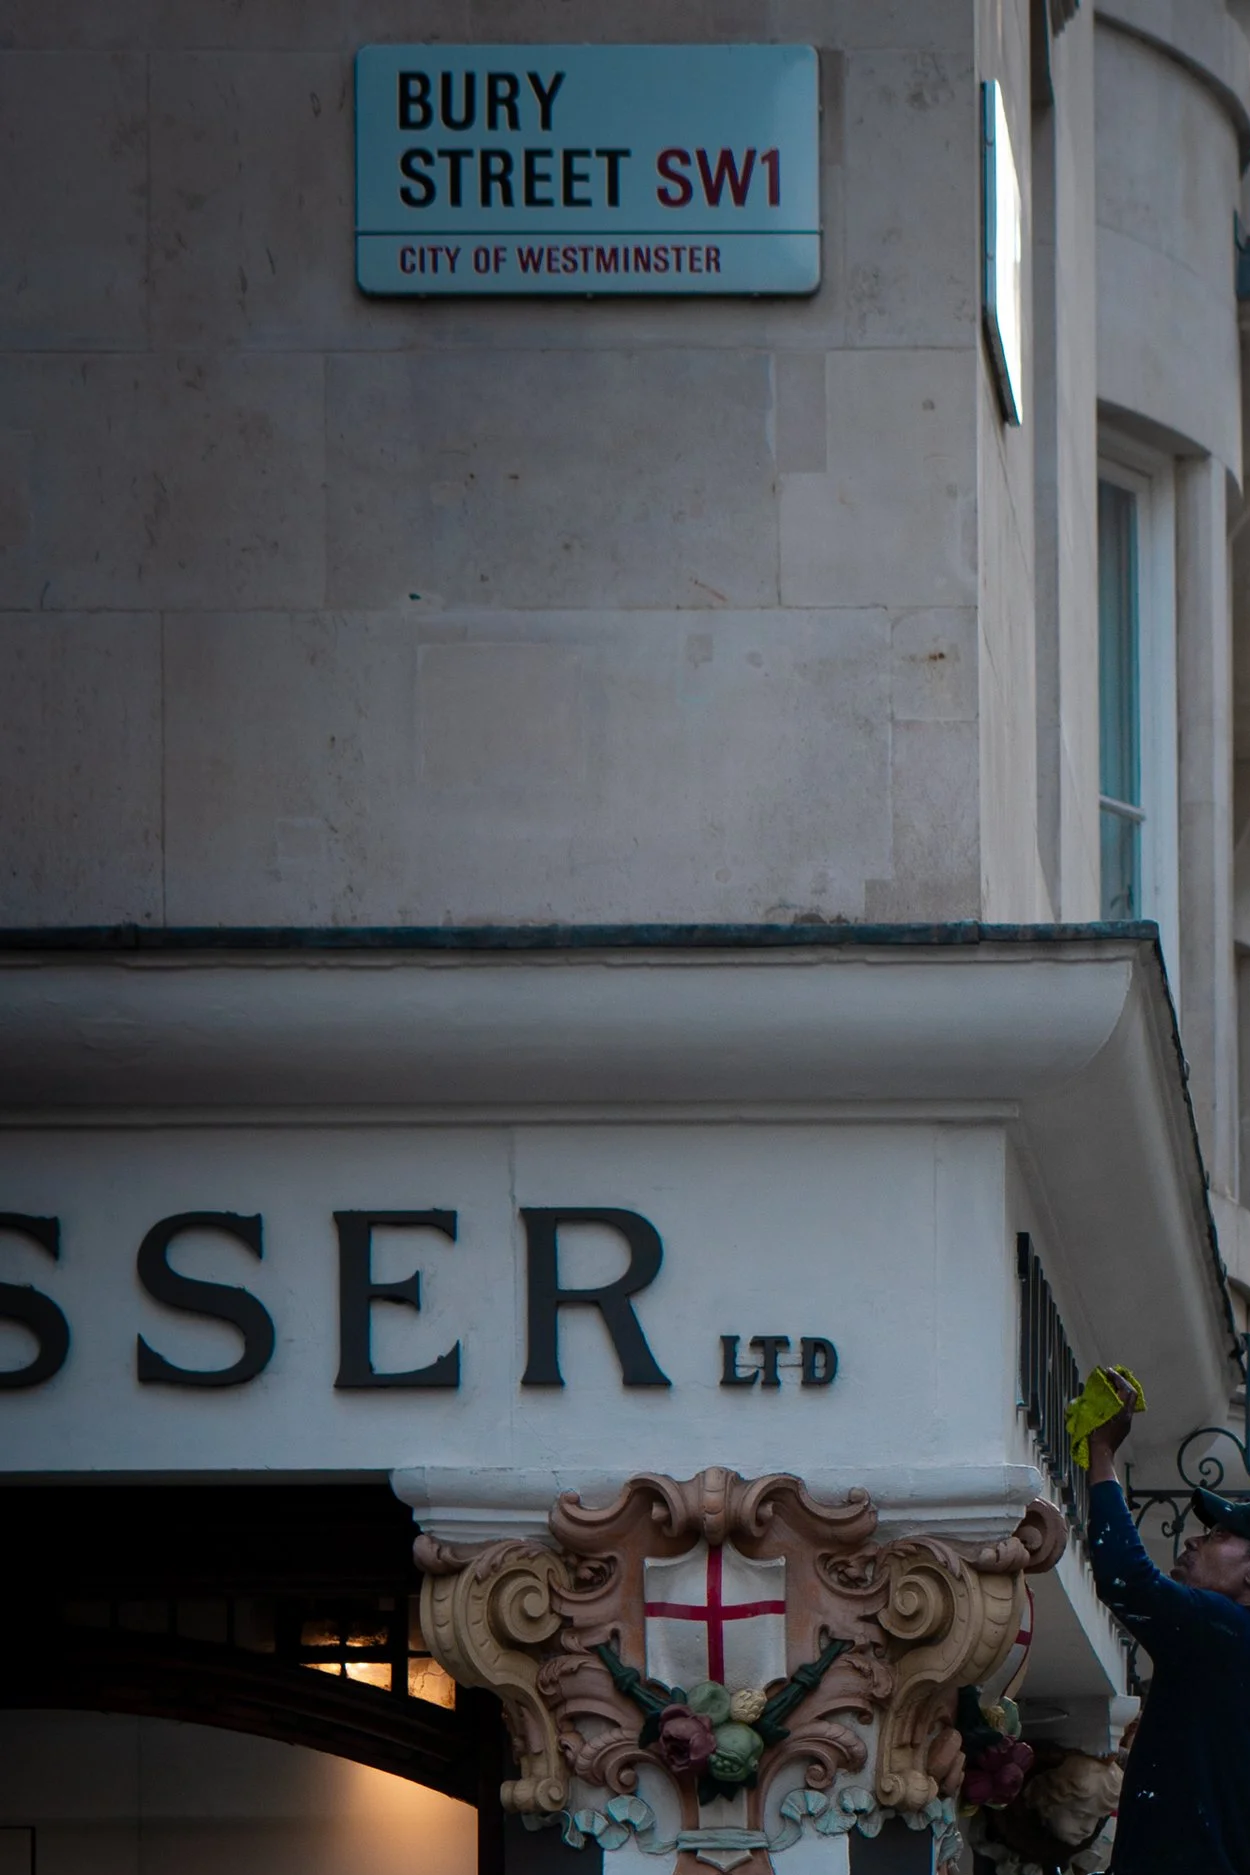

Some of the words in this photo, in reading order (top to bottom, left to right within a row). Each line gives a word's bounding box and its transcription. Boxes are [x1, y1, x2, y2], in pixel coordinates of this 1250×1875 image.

[398, 71, 567, 131] BURY
[399, 148, 632, 208] STREET
[656, 148, 781, 208] SW1
[400, 246, 462, 275] CITY
[473, 246, 508, 275] OF
[518, 246, 722, 275] WESTMINSTER
[718, 1334, 839, 1387] LTD
